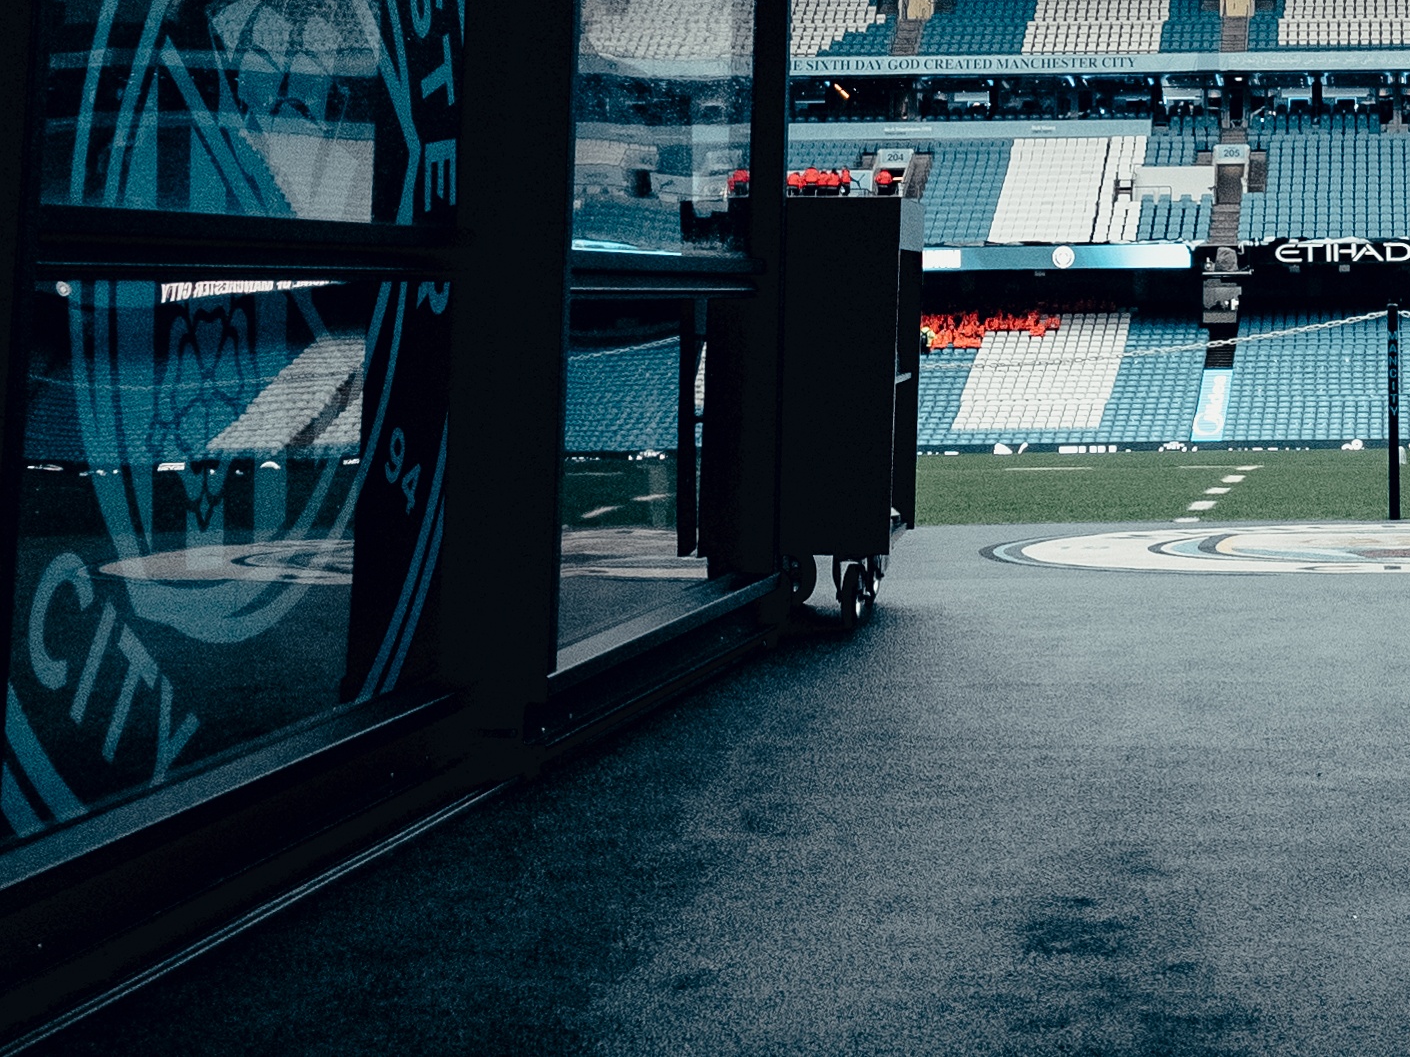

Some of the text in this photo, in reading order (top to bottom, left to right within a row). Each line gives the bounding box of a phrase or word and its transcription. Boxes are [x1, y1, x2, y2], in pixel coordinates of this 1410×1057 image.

[789, 56, 1137, 71] E SIXTH DAY GOD CREATED MANCHESTER CITY
[887, 153, 904, 161] 204
[1223, 149, 1240, 158] 205
[384, 427, 421, 515] 94
[28, 551, 201, 788] CITY
